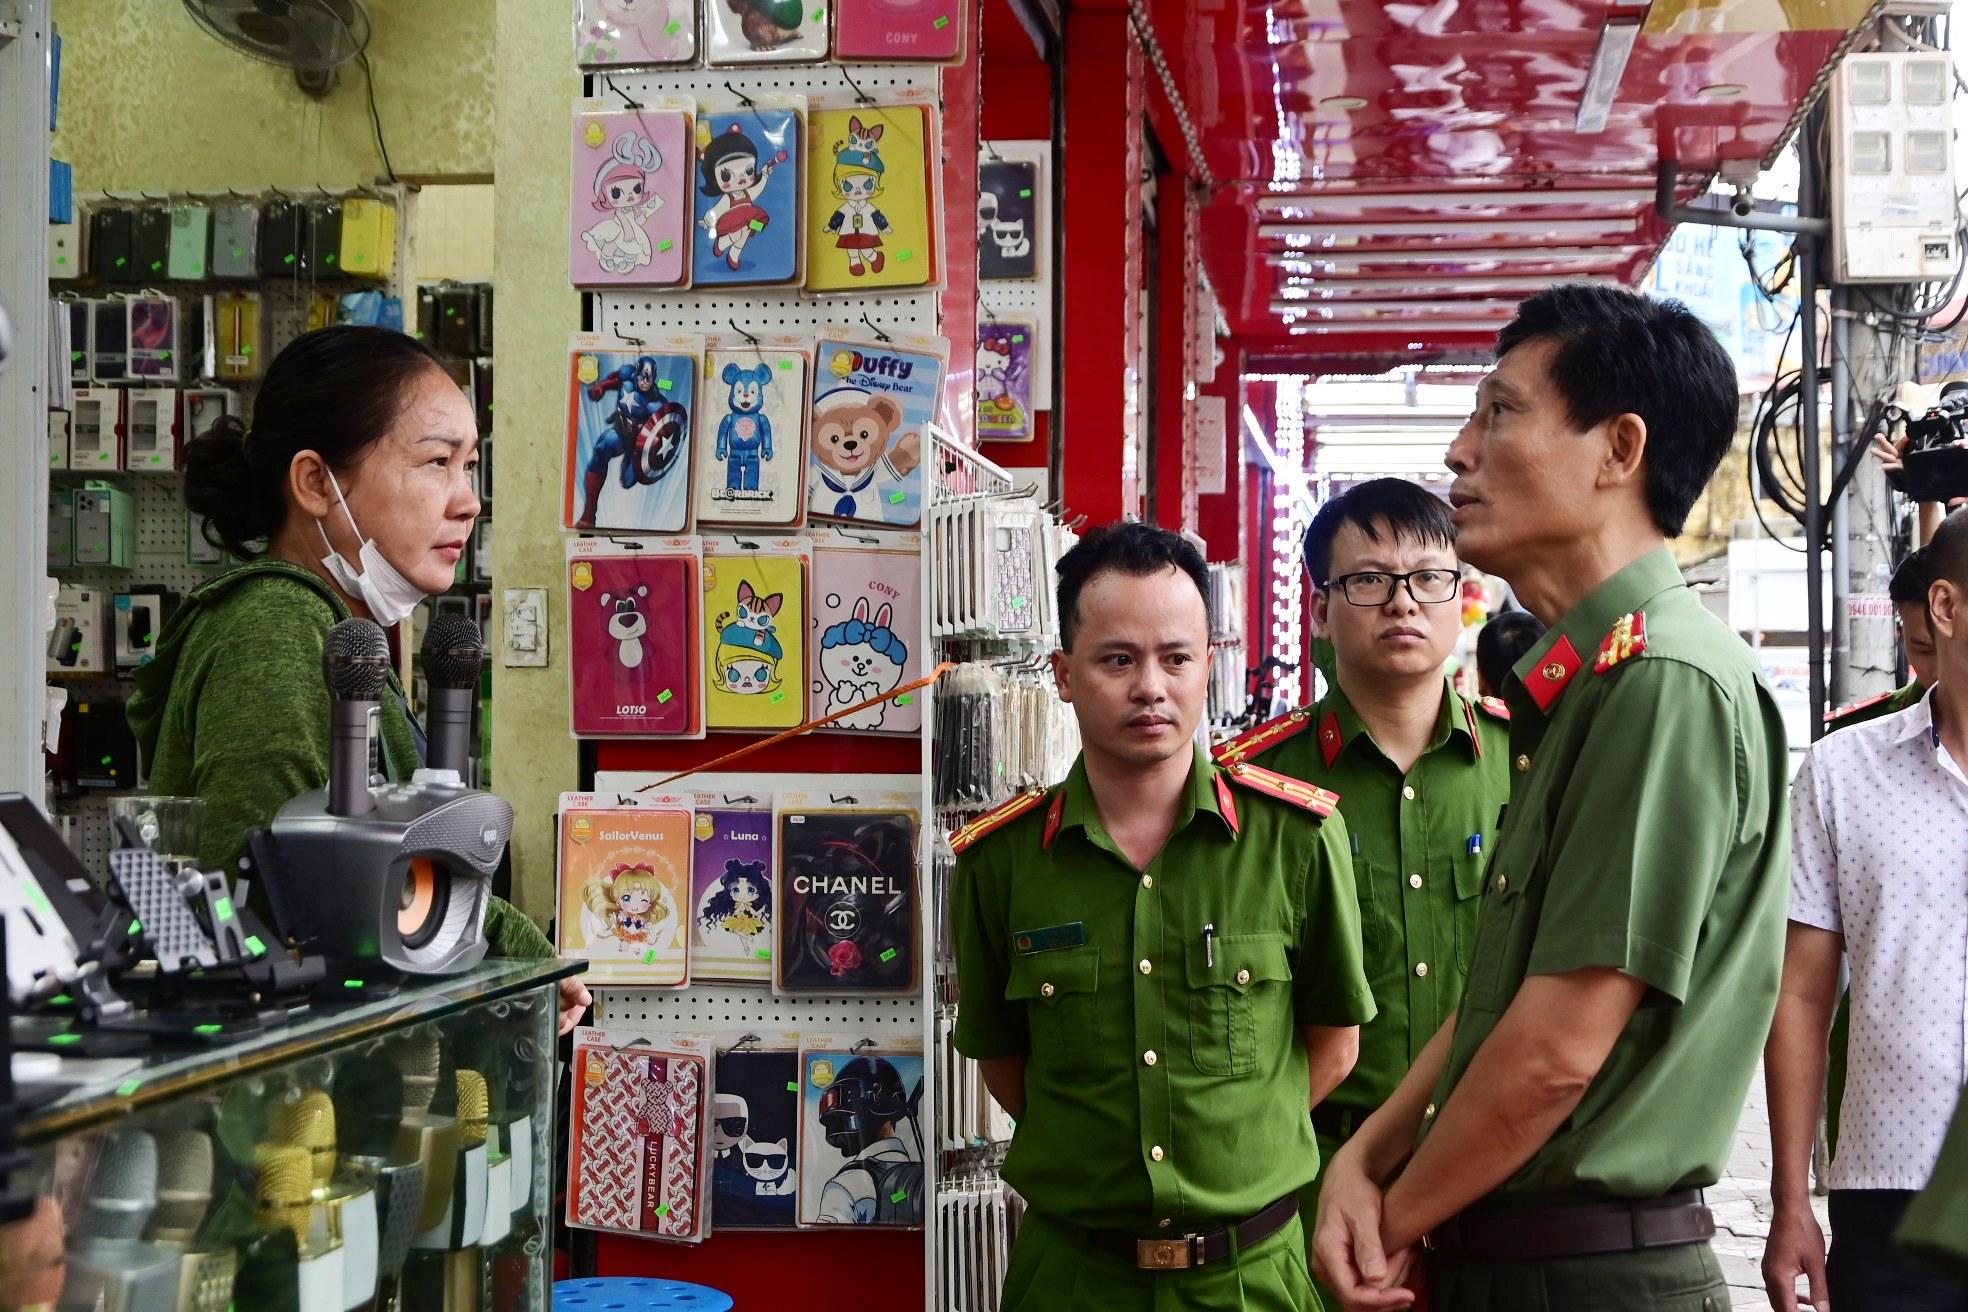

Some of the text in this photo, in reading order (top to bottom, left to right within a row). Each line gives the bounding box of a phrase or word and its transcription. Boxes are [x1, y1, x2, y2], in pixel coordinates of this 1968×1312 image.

[886, 32, 918, 44] CONY
[848, 350, 913, 380] Duffy
[858, 373, 891, 392] Disney
[893, 382, 914, 393] Bear
[868, 580, 901, 600] CONY
[616, 705, 647, 715] LOTSO
[599, 830, 664, 841] SailorVenus
[730, 830, 759, 841] Luna
[793, 875, 902, 895] CHANEL
[581, 1029, 606, 1038] LEATHER
[646, 1141, 658, 1208] LUCKYBEAR
